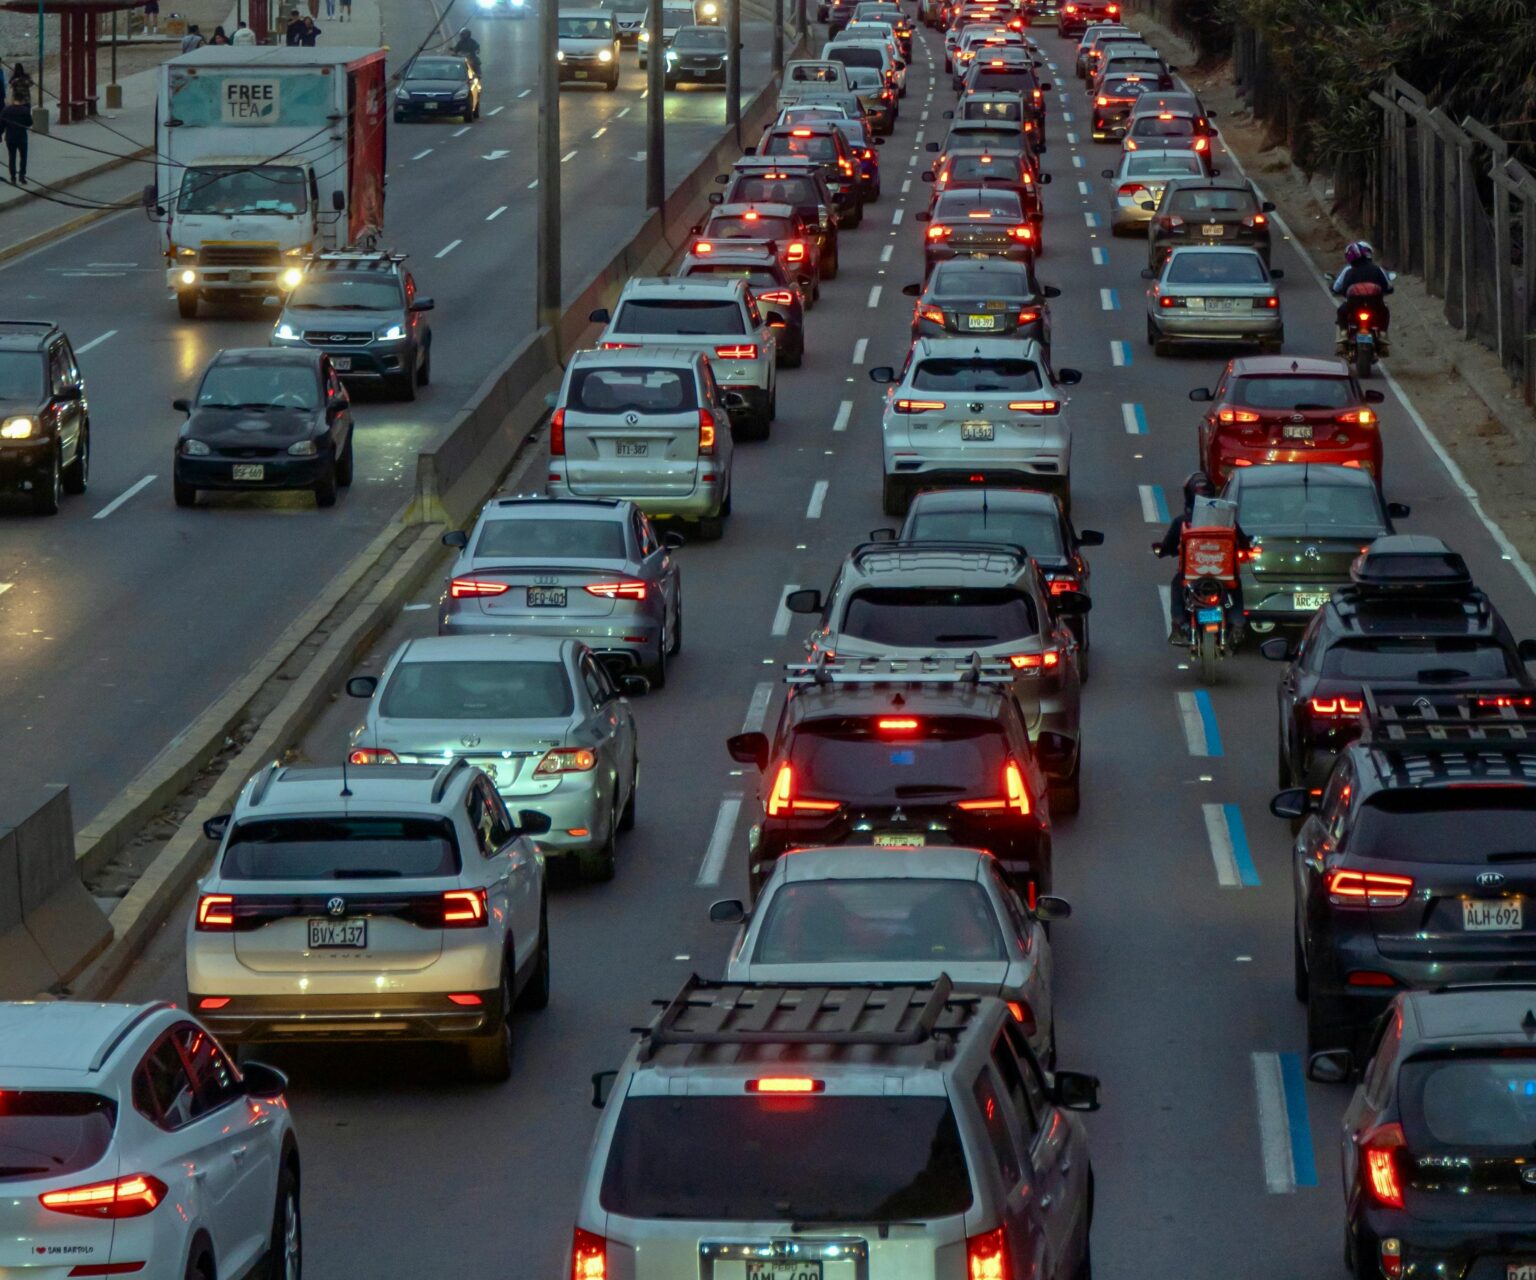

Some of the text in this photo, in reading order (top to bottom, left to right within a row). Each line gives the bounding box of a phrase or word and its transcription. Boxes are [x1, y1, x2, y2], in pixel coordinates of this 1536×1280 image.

[227, 84, 273, 100] FREE
[227, 102, 260, 118] TEA
[1481, 874, 1500, 885] KIA
[1467, 909, 1519, 926] ALH-692
[312, 927, 363, 944] BVX-137
[47, 1246, 62, 1255] SAN
[63, 1246, 94, 1255] BARTOLO
